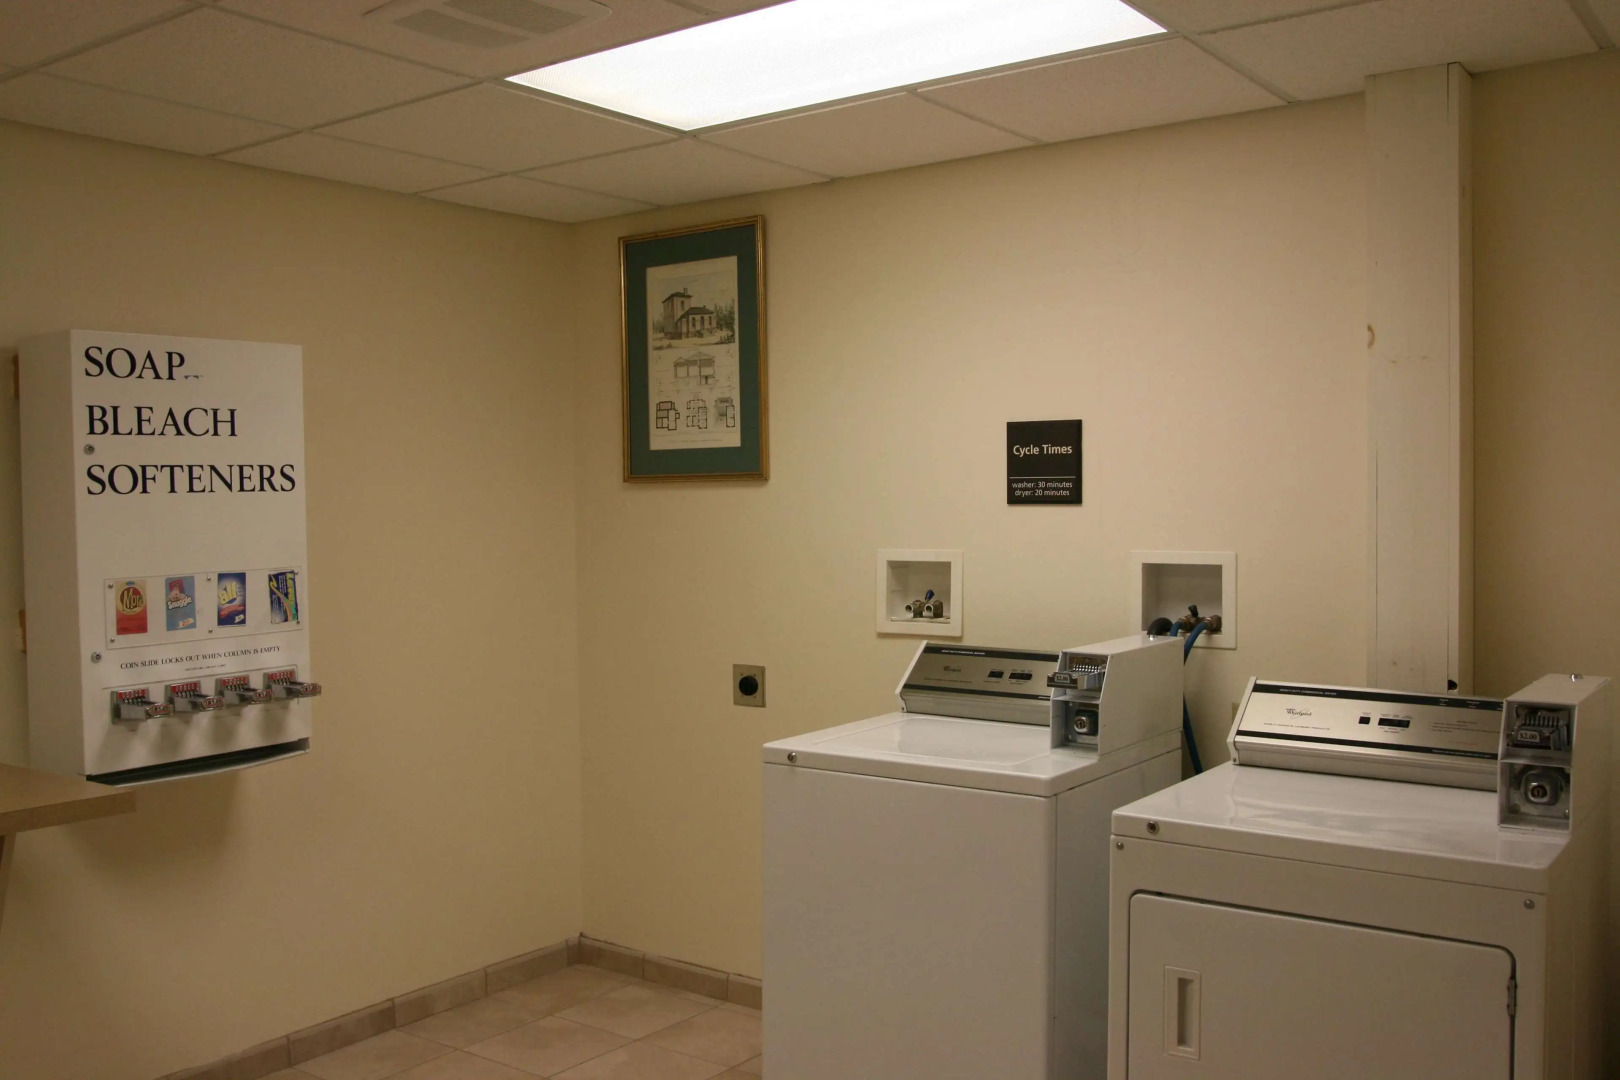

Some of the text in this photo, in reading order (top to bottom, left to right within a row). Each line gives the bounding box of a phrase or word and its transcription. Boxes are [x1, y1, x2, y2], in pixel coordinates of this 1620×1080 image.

[84, 346, 185, 380] SOAP
[86, 404, 237, 436] BLEACH
[1013, 444, 1072, 457] Cycle Times
[86, 464, 296, 495] SOFTENERS
[167, 596, 192, 610] Snuggle
[162, 656, 184, 664] LOCKS
[224, 649, 252, 658] COLUMN
[260, 646, 280, 654] EMPTY
